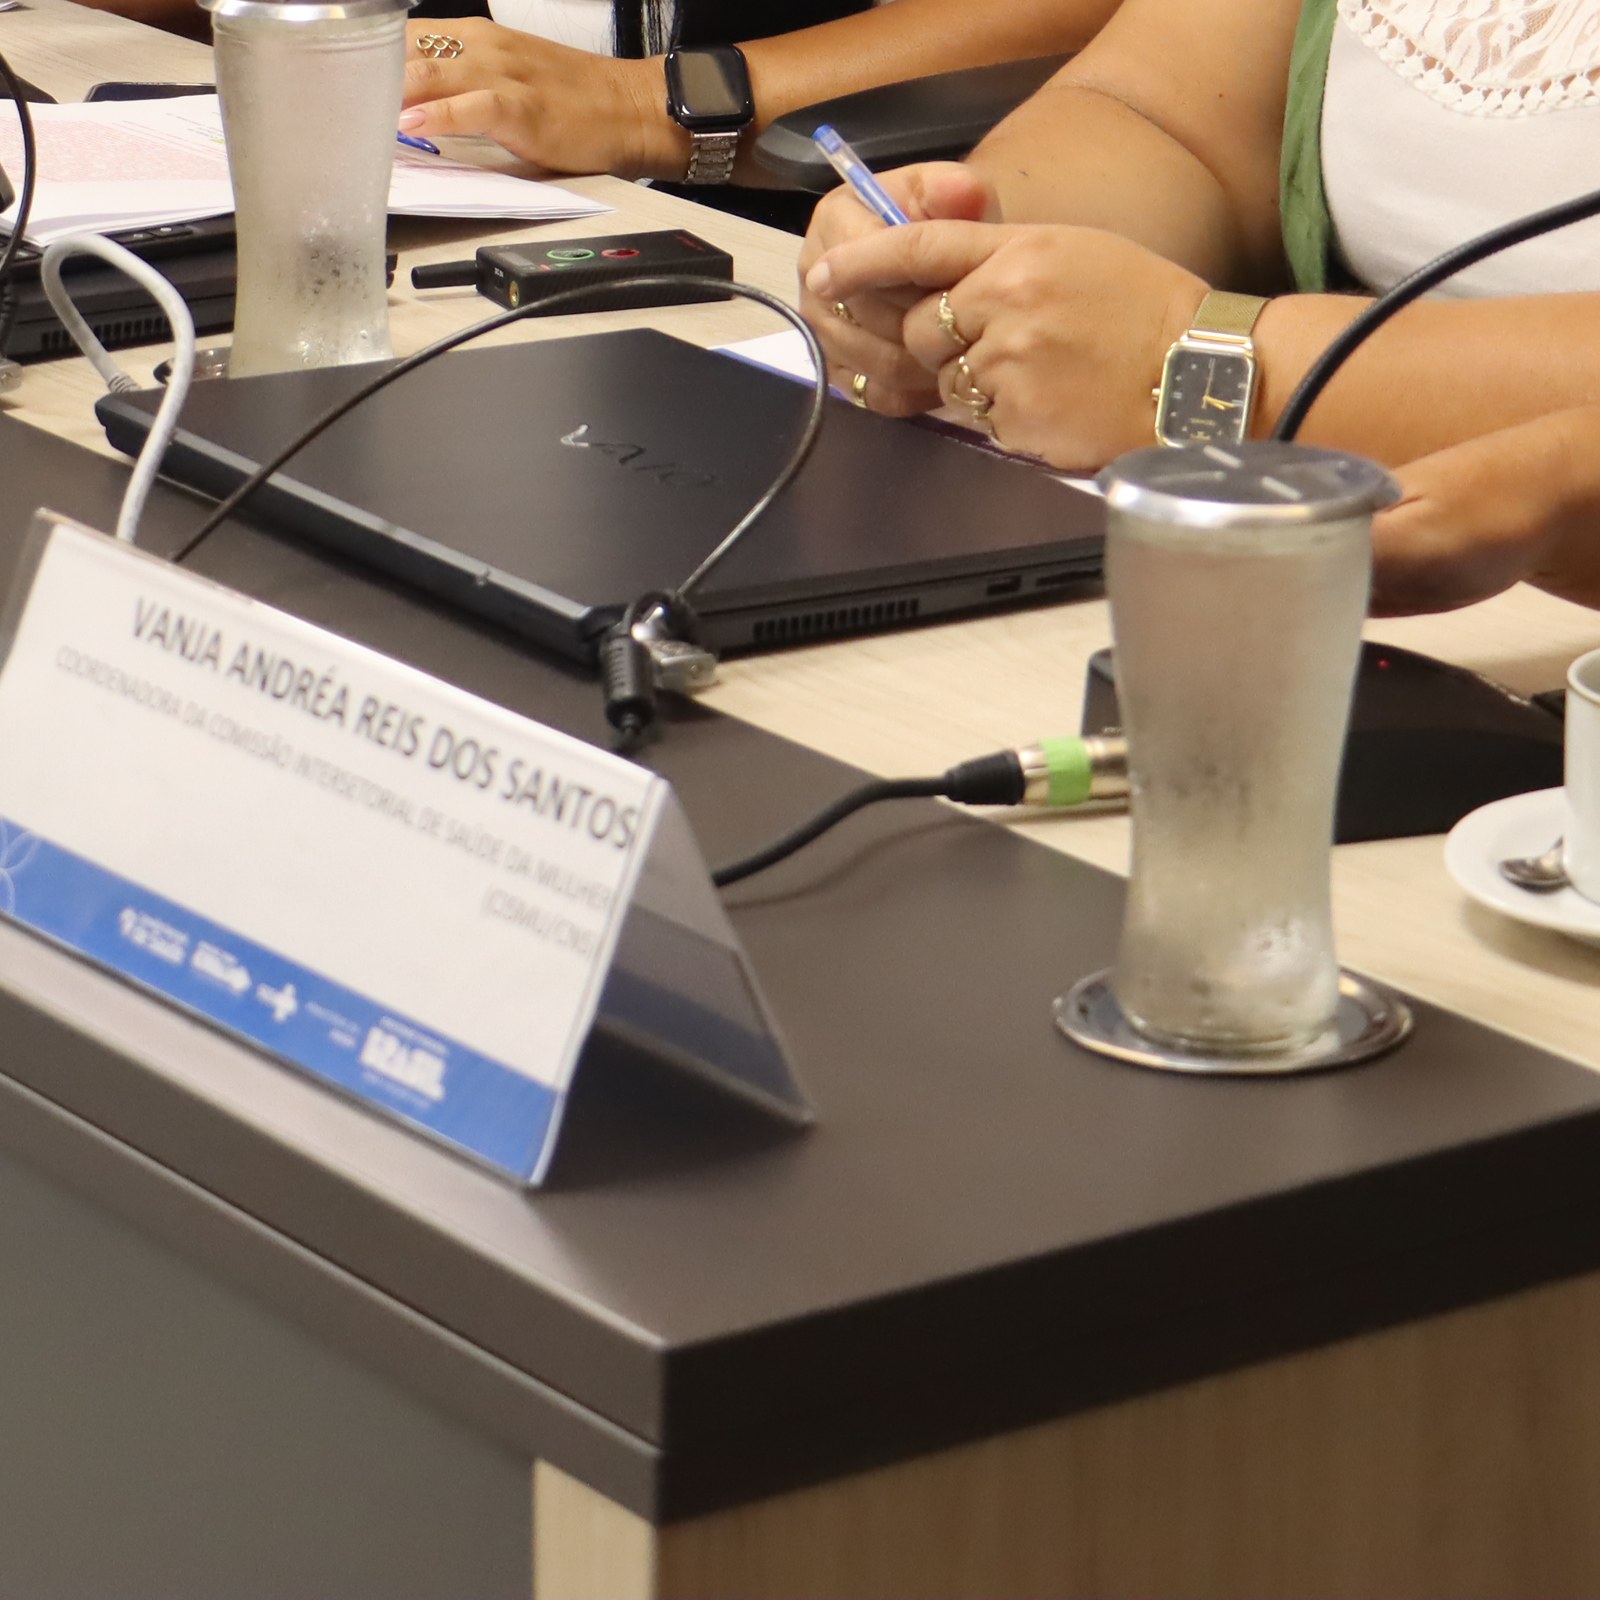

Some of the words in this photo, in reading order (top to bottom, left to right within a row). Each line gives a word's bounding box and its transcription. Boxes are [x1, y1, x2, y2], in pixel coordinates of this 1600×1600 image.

[133, 596, 223, 672] VANJA
[226, 642, 350, 728] ANDRÉA
[354, 694, 425, 758] REIS
[427, 727, 498, 789] DOS
[501, 759, 637, 850] SANTOS
